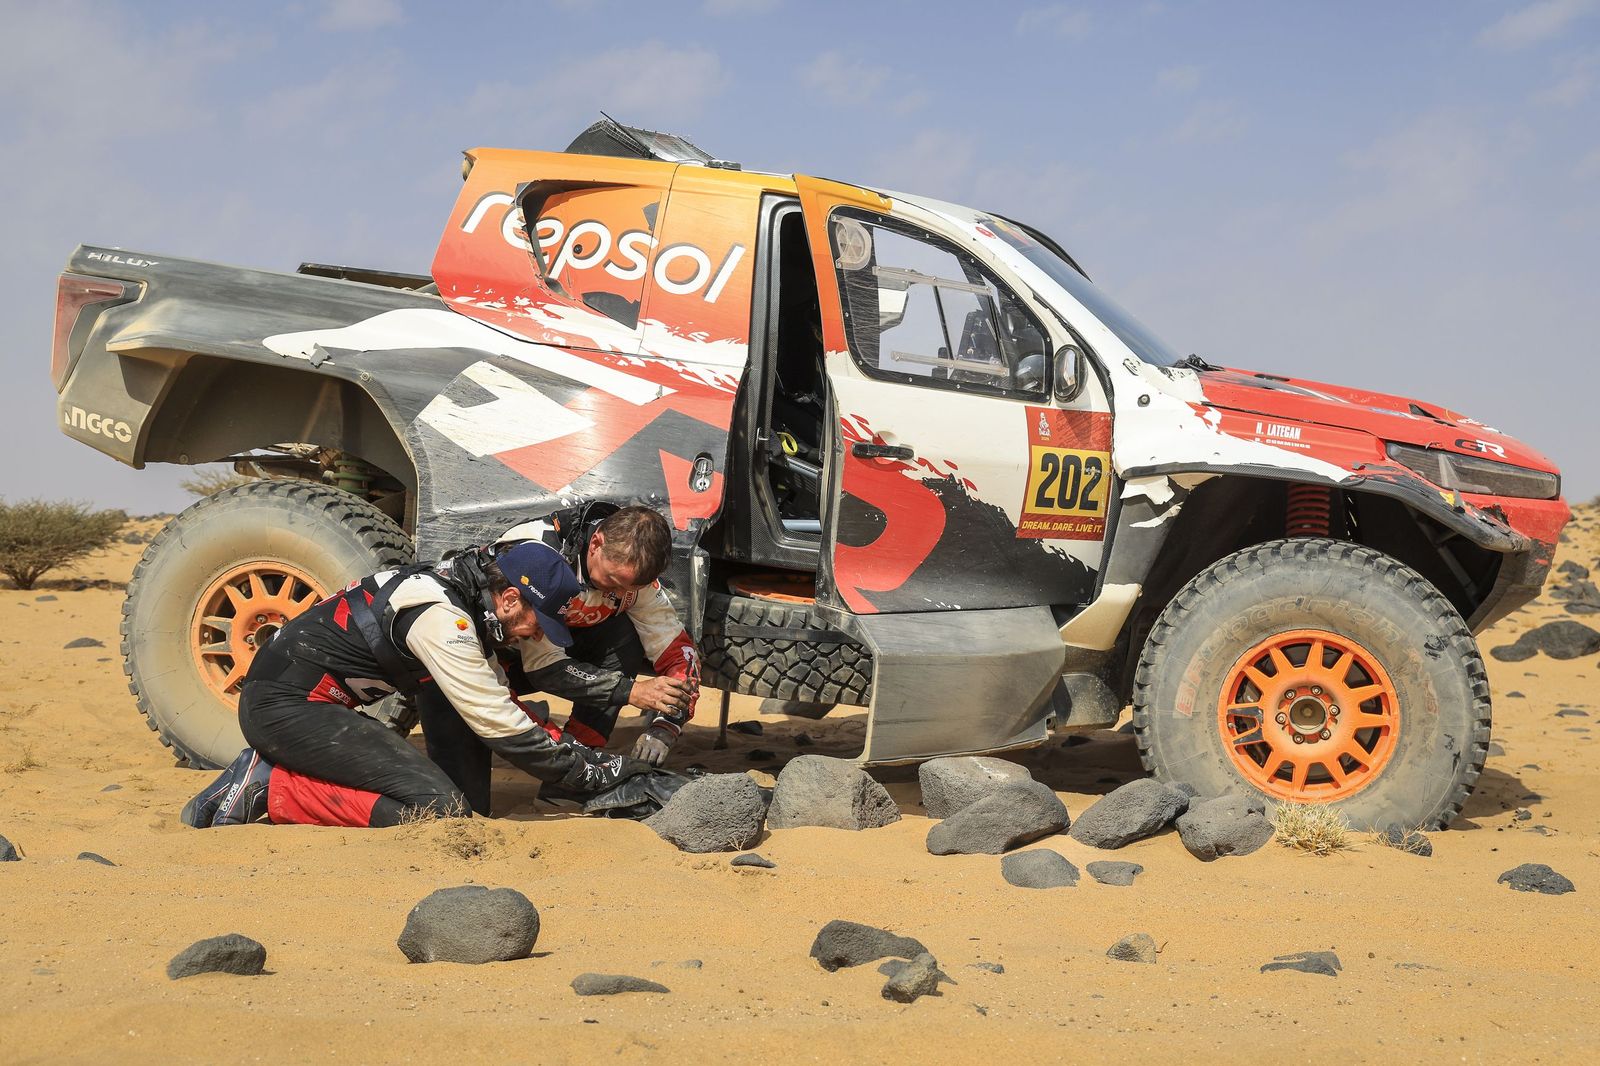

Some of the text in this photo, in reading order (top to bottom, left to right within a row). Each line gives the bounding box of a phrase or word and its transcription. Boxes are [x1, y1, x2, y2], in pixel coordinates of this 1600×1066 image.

[461, 190, 747, 304] repsol
[87, 252, 160, 268] HILUX
[1266, 423, 1302, 441] LATEGAN
[1454, 438, 1508, 459] GR
[1034, 452, 1103, 511] 202
[1021, 520, 1051, 531] DREAM.
[1051, 522, 1075, 533] DARE.
[1075, 524, 1094, 533] LIVE
[528, 584, 547, 600] repsol
